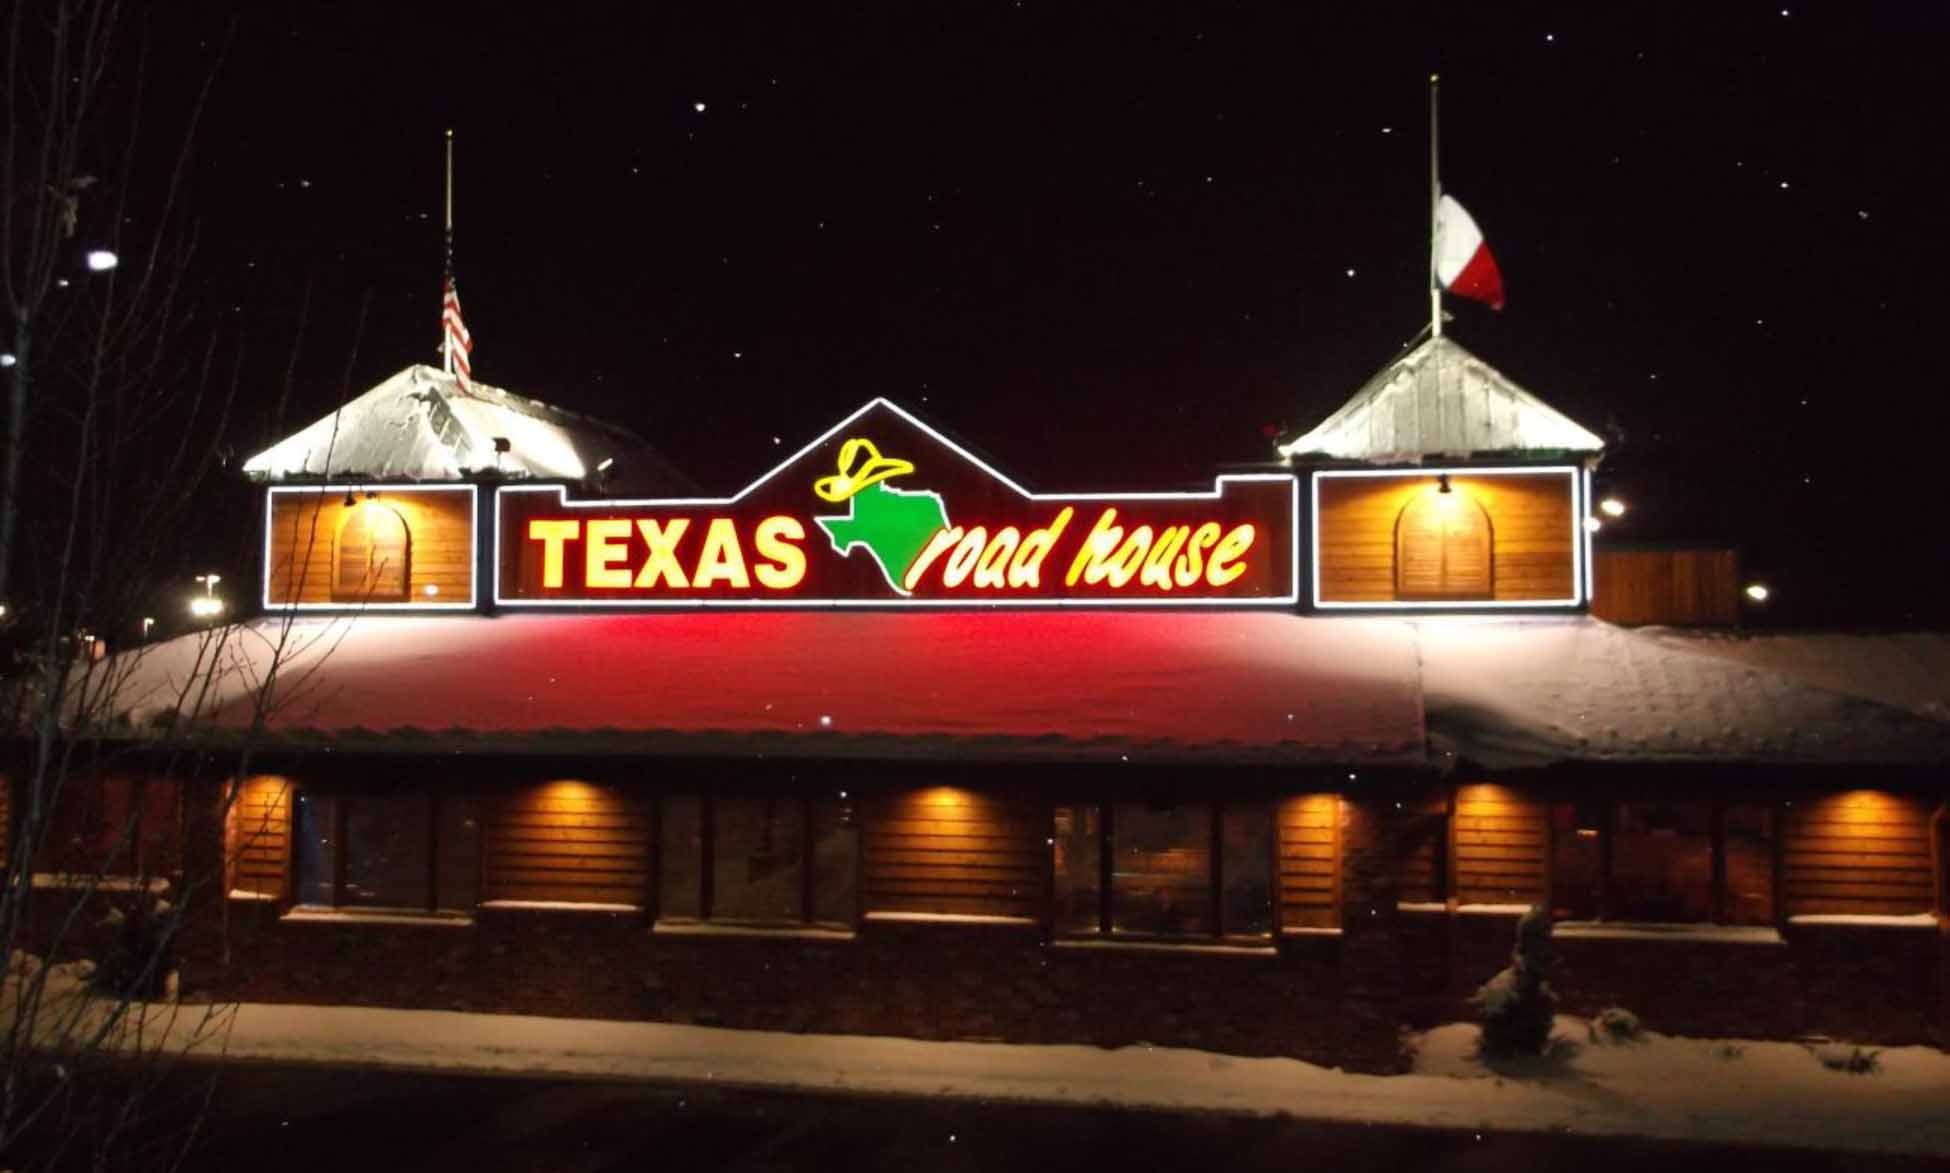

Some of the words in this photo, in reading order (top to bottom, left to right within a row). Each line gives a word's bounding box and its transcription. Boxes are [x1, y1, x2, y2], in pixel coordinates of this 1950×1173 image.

[529, 516, 808, 588] TEXAS
[904, 506, 1074, 591] road
[1065, 507, 1255, 590] house
